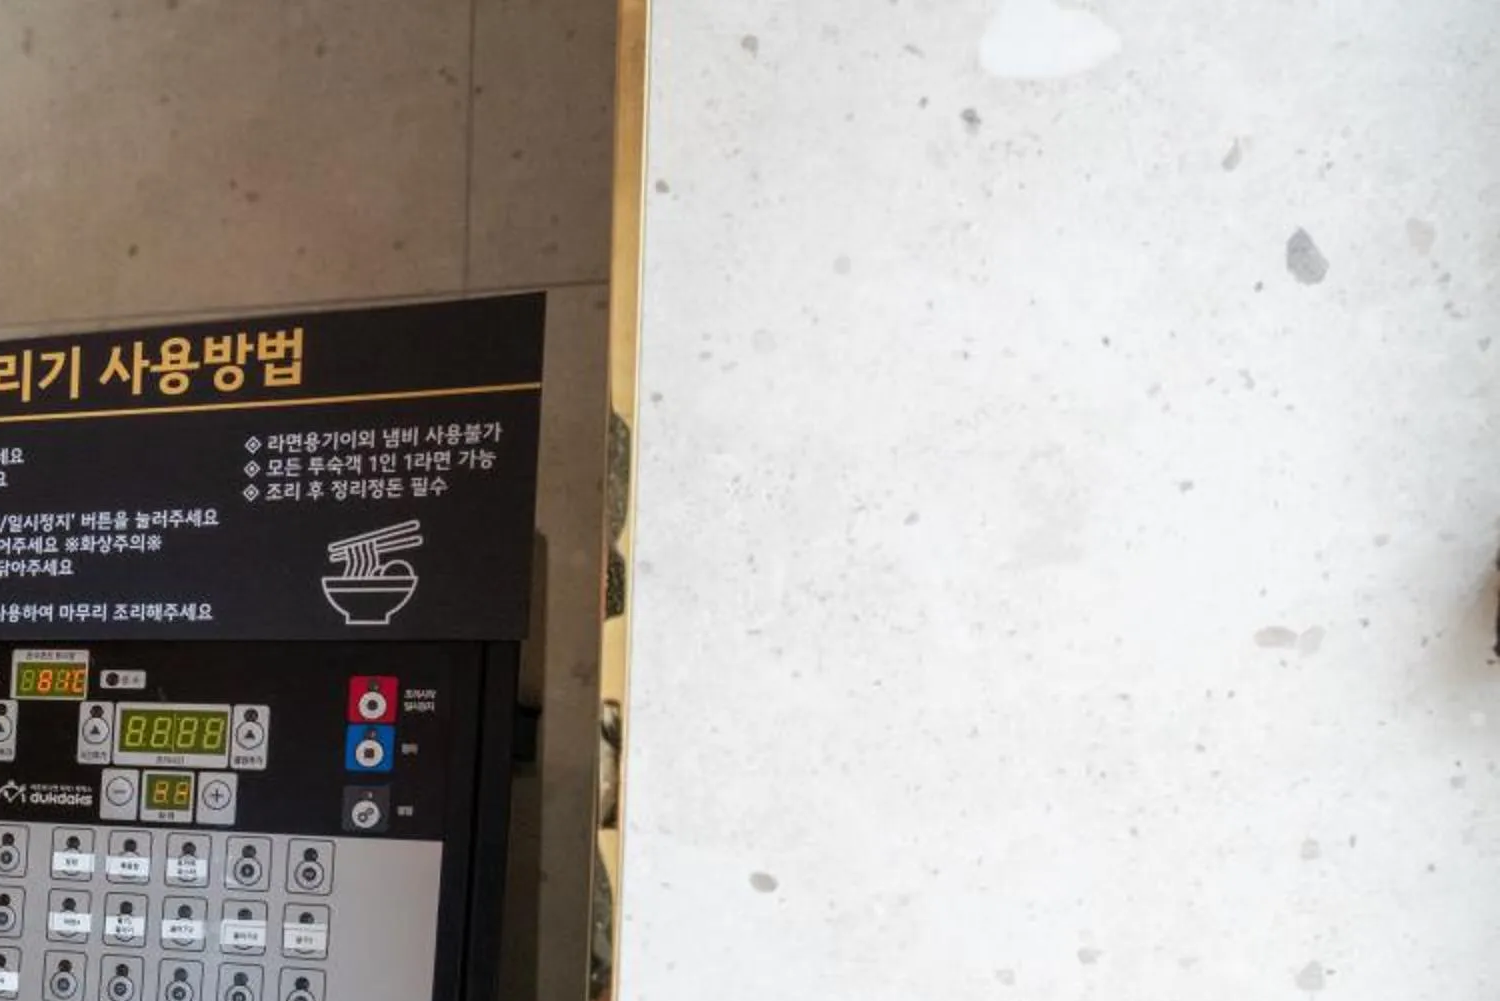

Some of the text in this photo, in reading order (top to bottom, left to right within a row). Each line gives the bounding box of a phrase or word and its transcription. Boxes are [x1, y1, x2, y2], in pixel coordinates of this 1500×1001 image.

[99, 327, 304, 396] 사용방법
[267, 422, 503, 452] 라면용기이외 냄비 사용불가
[266, 449, 497, 477] 모든 투숙객 1인 1라면 가능
[266, 476, 449, 501] 조리 후 정리정돈 필수
[81, 511, 128, 530] 버튼을
[136, 508, 219, 529] 눌러주세요
[59, 604, 107, 622] 마무리
[113, 603, 213, 623] 조리해주세요
